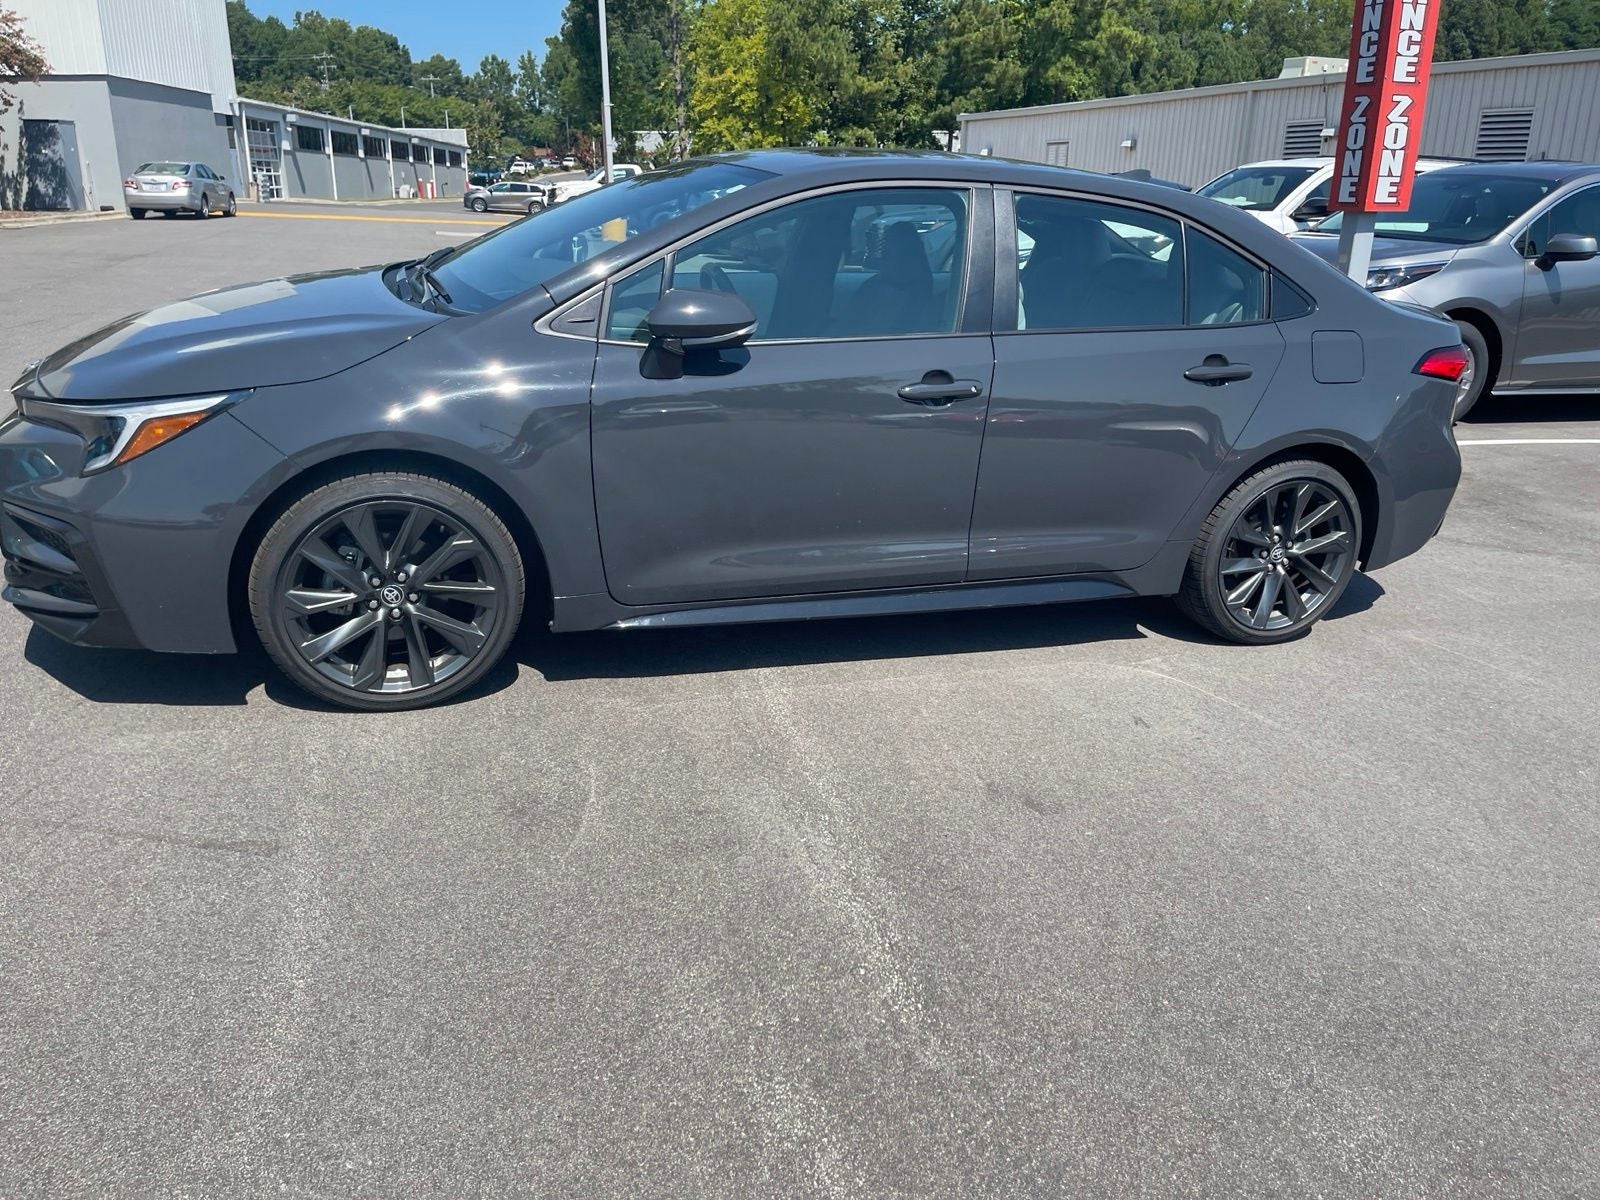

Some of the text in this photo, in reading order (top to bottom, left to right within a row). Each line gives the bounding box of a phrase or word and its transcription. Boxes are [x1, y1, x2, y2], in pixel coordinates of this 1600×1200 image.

[1337, 0, 1384, 203] NCE ZONE
[1373, 0, 1428, 203] NCE ZONE
